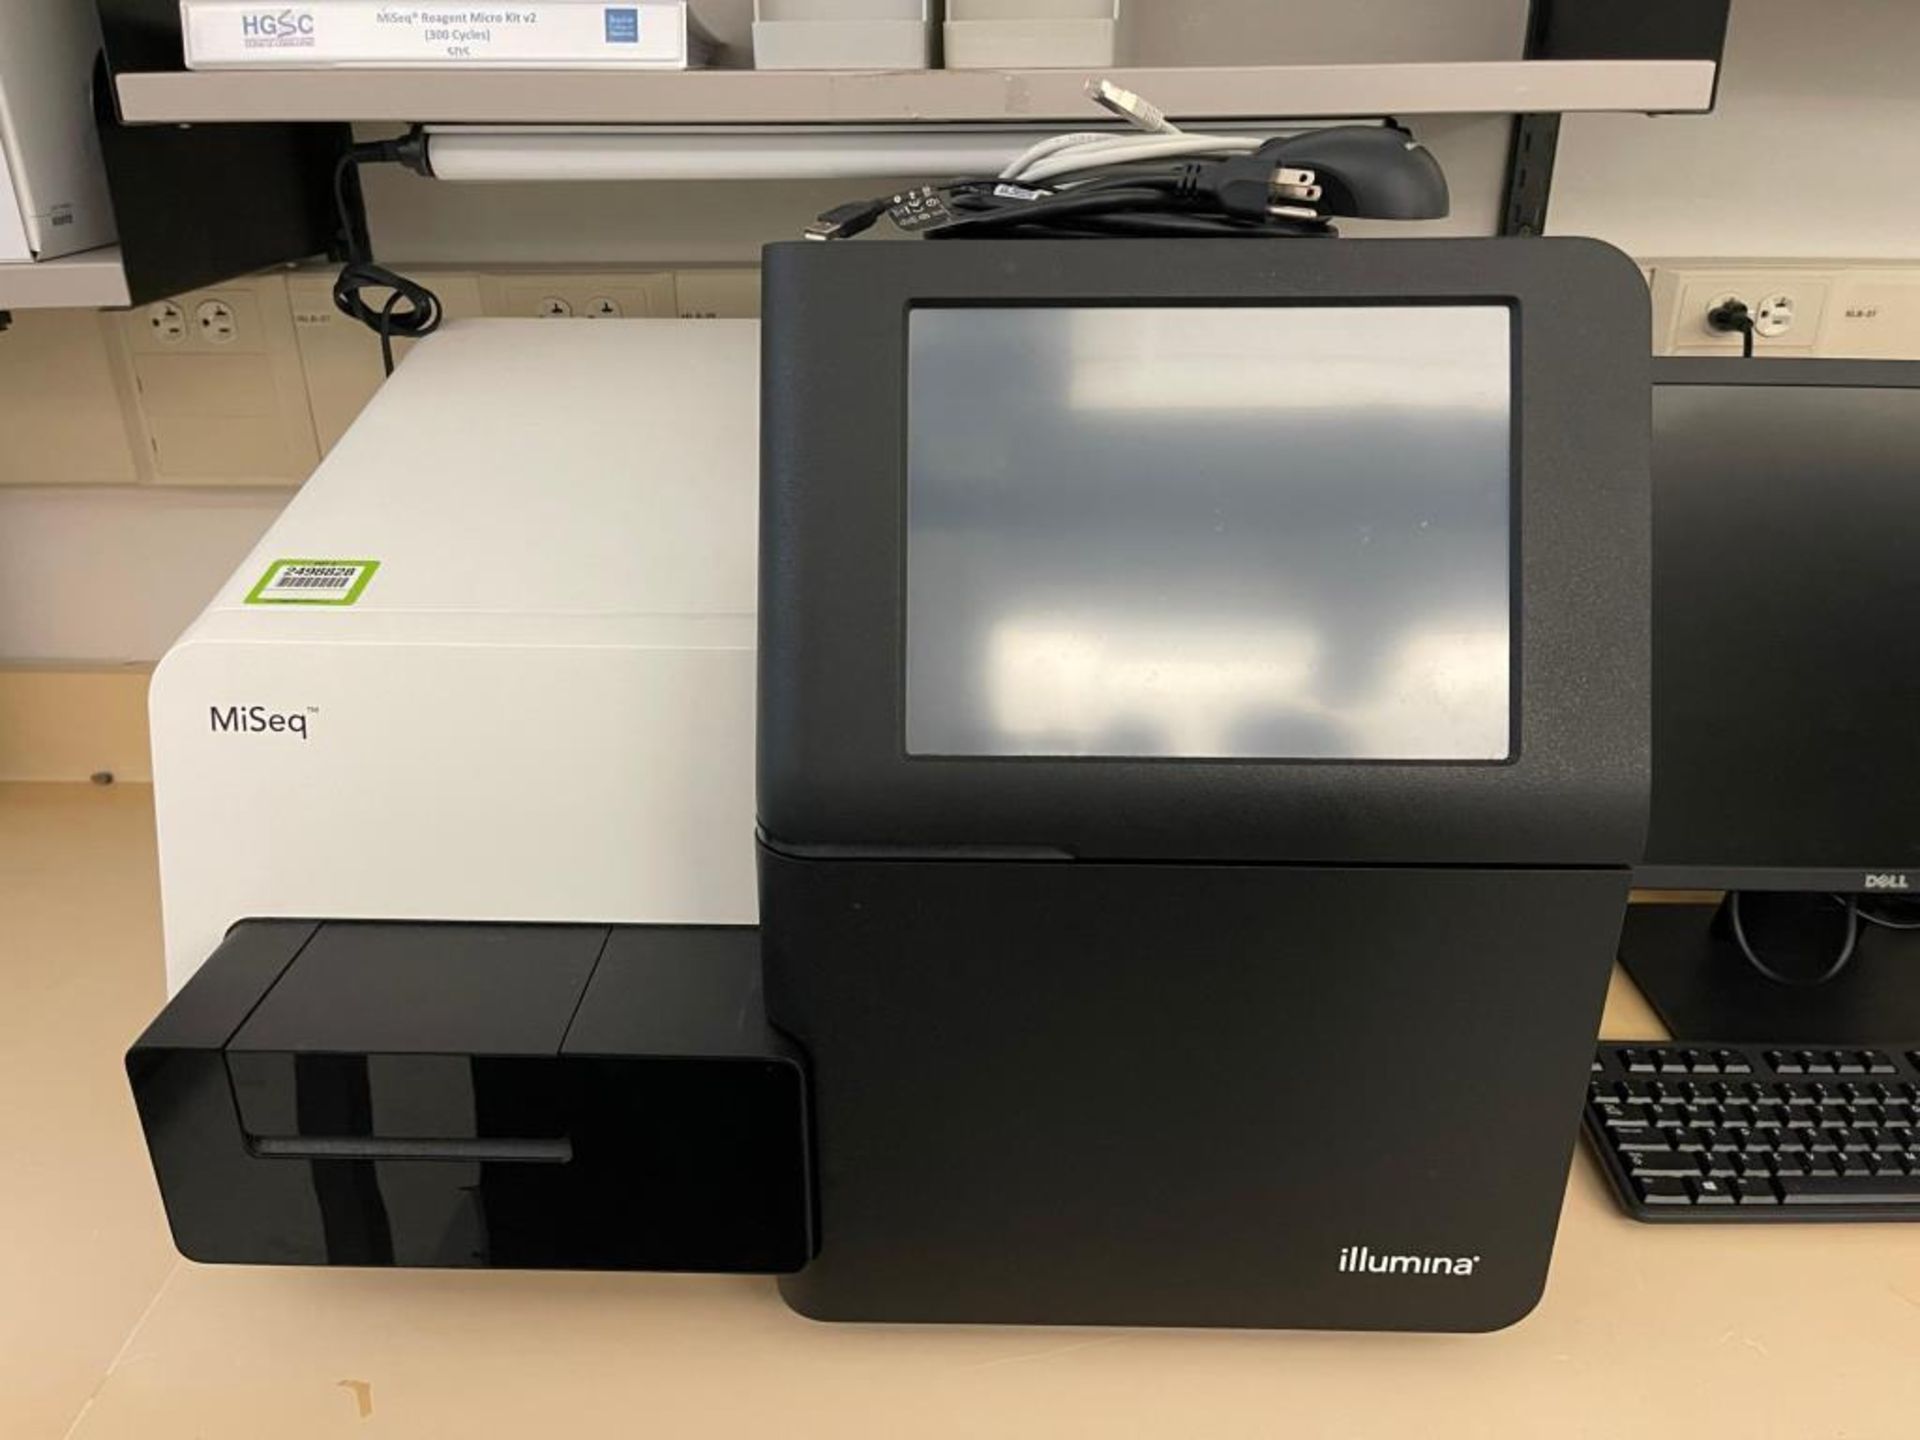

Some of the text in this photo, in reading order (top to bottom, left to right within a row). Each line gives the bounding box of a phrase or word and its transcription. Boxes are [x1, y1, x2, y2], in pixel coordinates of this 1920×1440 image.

[421, 12, 467, 24] Reagent
[470, 12, 502, 23] Micro
[505, 12, 520, 23] Kit
[523, 13, 536, 23] v2
[1865, 874, 1909, 888] DELL
